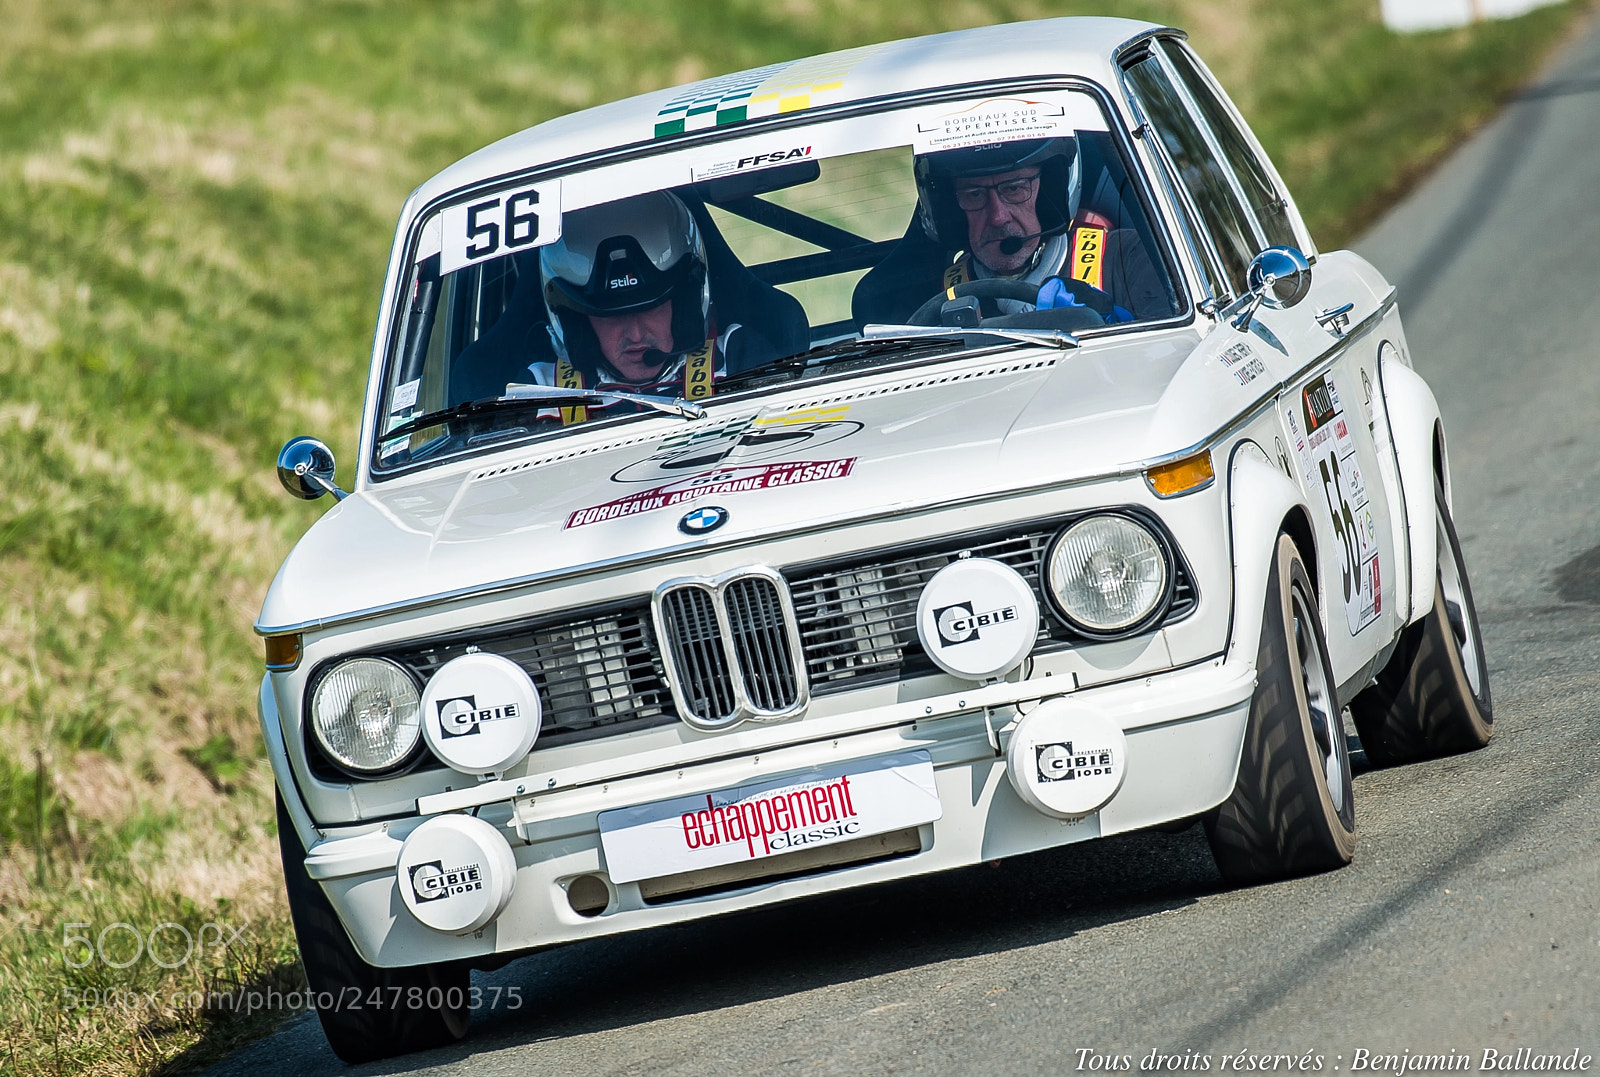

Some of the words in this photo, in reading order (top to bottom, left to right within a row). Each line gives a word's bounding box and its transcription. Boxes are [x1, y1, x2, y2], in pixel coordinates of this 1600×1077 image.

[945, 112, 1007, 126] BORDEAUX
[1013, 109, 1037, 117] SUD
[945, 116, 1037, 133] EXPERTISES
[737, 148, 804, 169] FFSA
[466, 189, 540, 260] 56
[610, 274, 638, 289] Stilo
[690, 472, 734, 486] 56
[571, 497, 665, 528] BORDEAUX
[668, 476, 764, 505] AQUITAINE
[767, 460, 847, 487] CLASSIC
[1318, 450, 1361, 604] 56
[1077, 767, 1112, 777] IODE
[681, 774, 858, 858] echappement
[769, 819, 861, 850] classic
[450, 881, 482, 895] IODE
